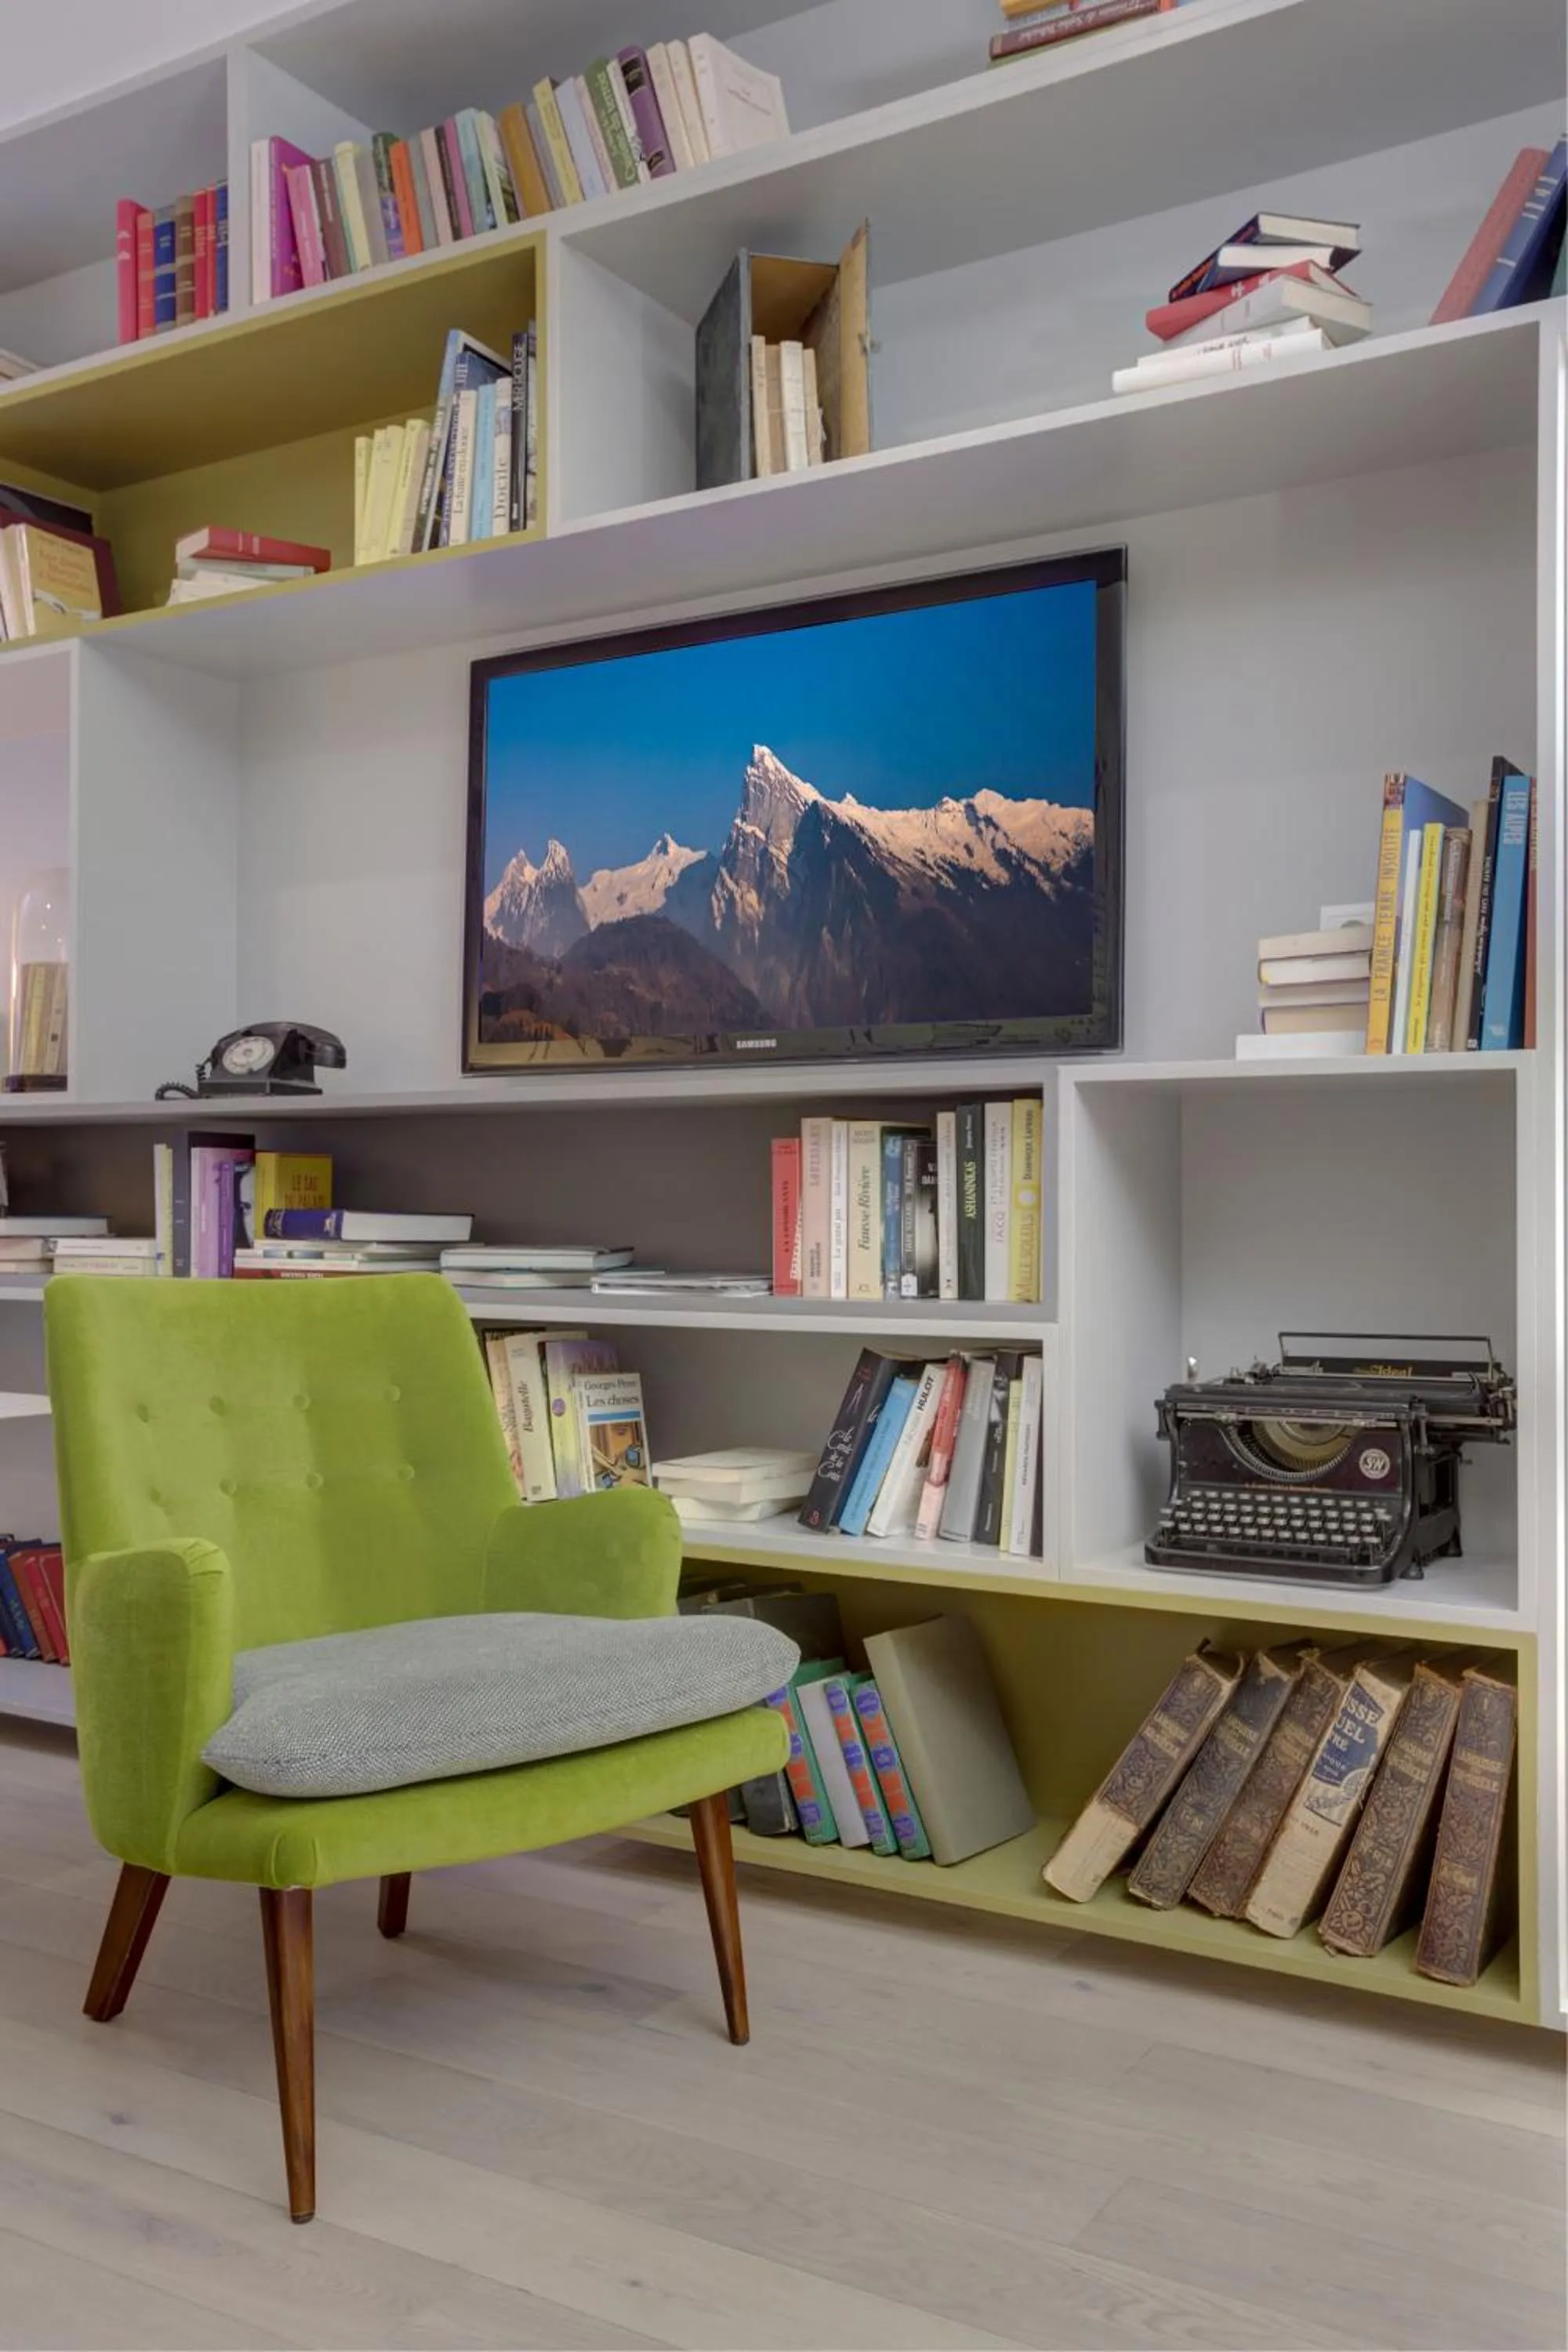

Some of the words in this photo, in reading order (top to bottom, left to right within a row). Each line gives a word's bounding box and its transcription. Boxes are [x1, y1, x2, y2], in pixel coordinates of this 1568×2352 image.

[1381, 828, 1399, 880] INSOLITE
[1378, 890, 1396, 926] TERRE
[1374, 935, 1392, 979] FRANCE
[1373, 988, 1387, 1002] LA
[737, 1039, 777, 1049] SAMSUNG
[916, 1374, 936, 1413] HULOT
